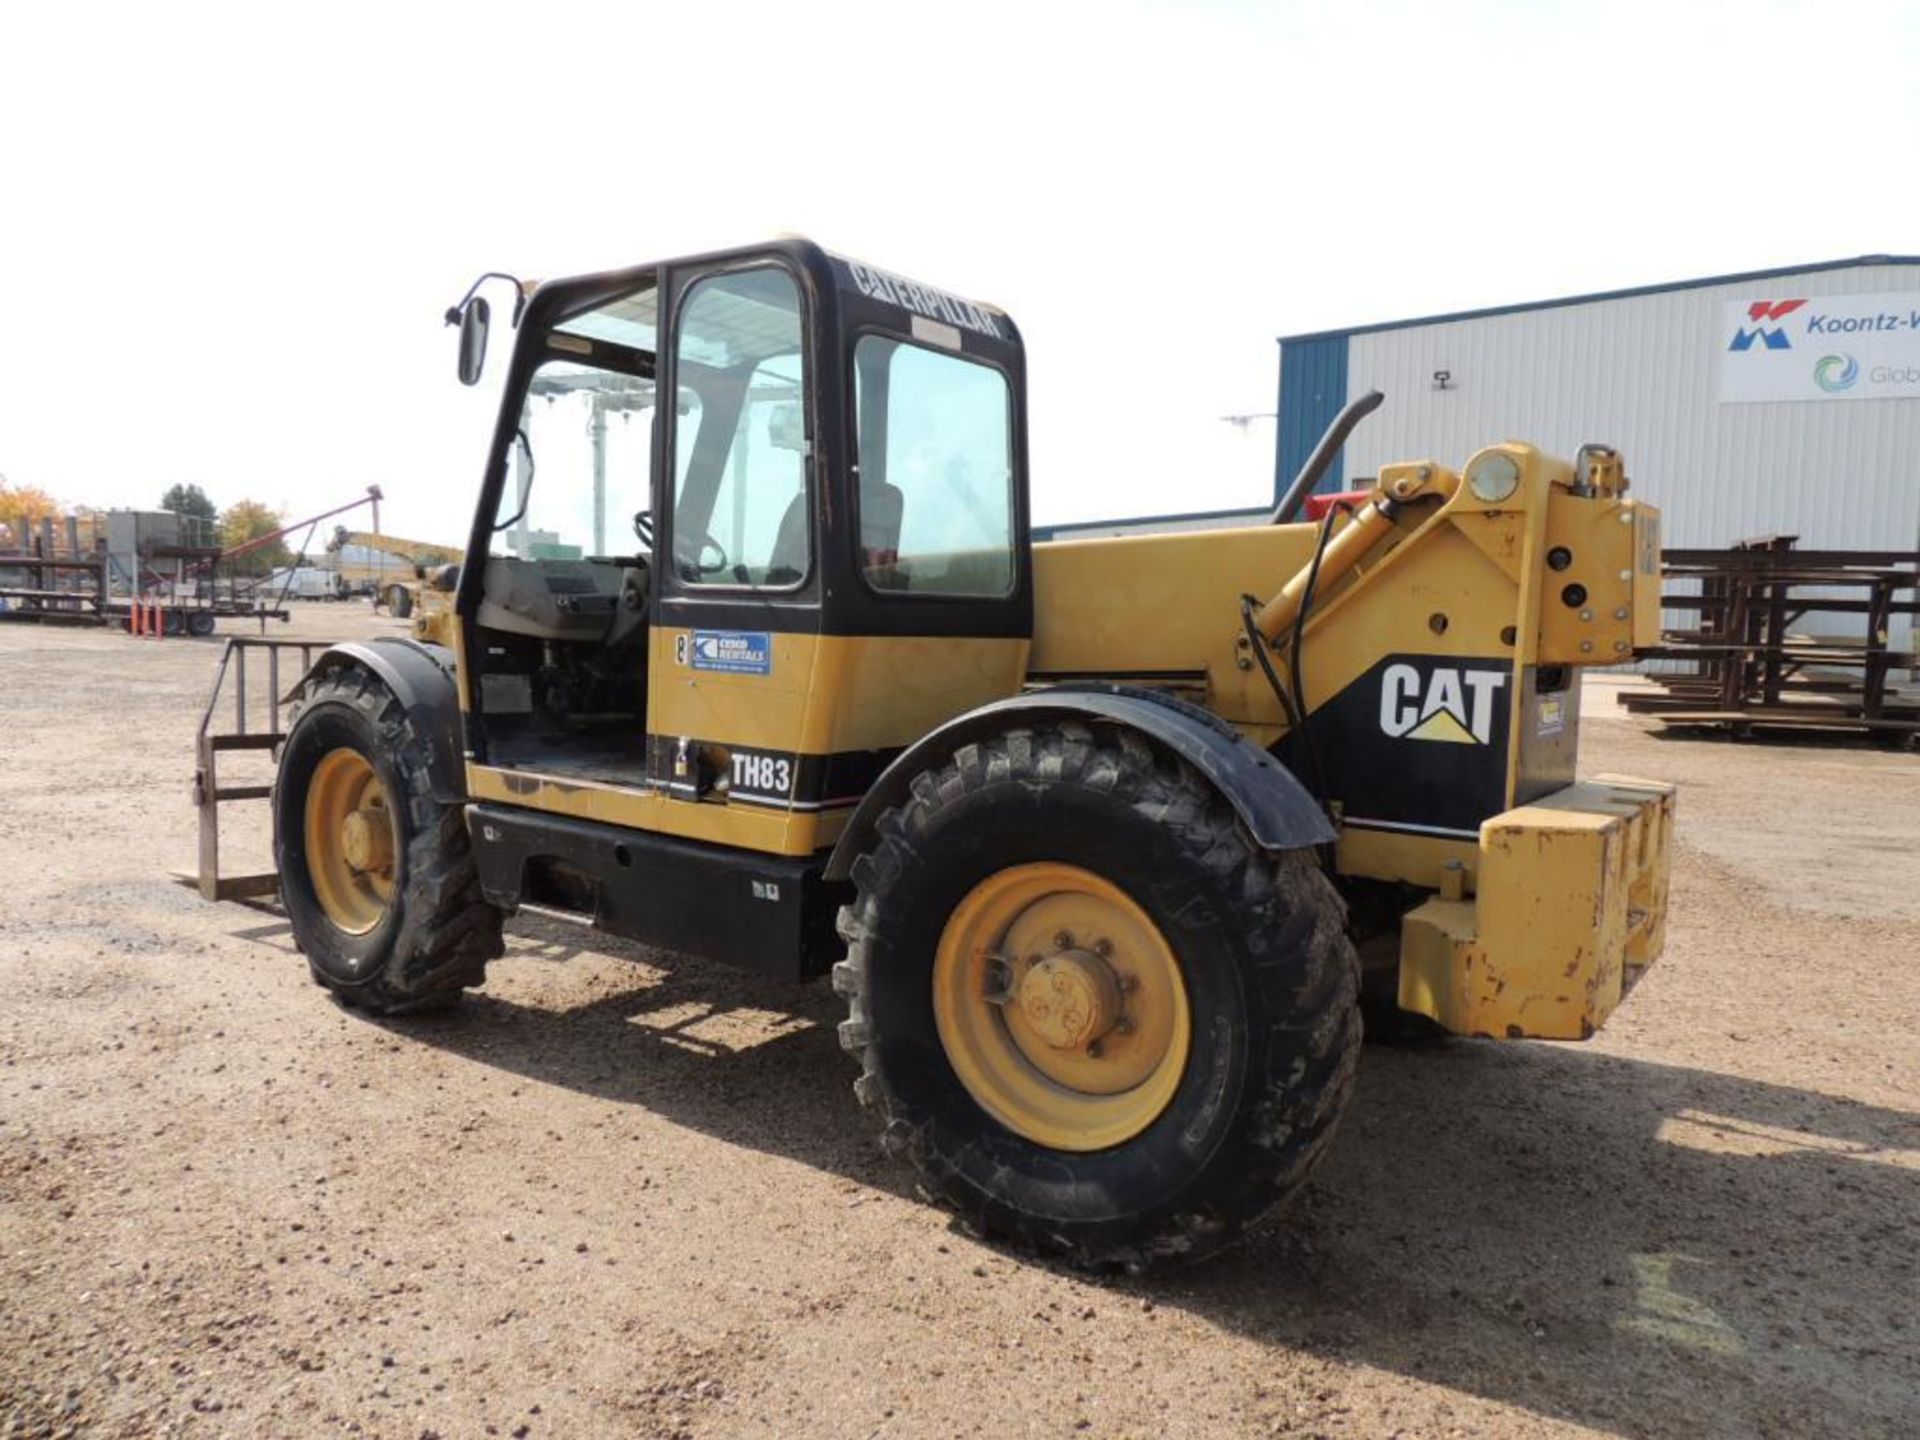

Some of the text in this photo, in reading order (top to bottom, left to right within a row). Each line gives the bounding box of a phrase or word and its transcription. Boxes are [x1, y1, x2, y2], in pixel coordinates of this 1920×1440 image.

[850, 264, 1001, 339] CATERPILLAR
[1380, 664, 1505, 745] CAT
[731, 754, 790, 791] TH83
